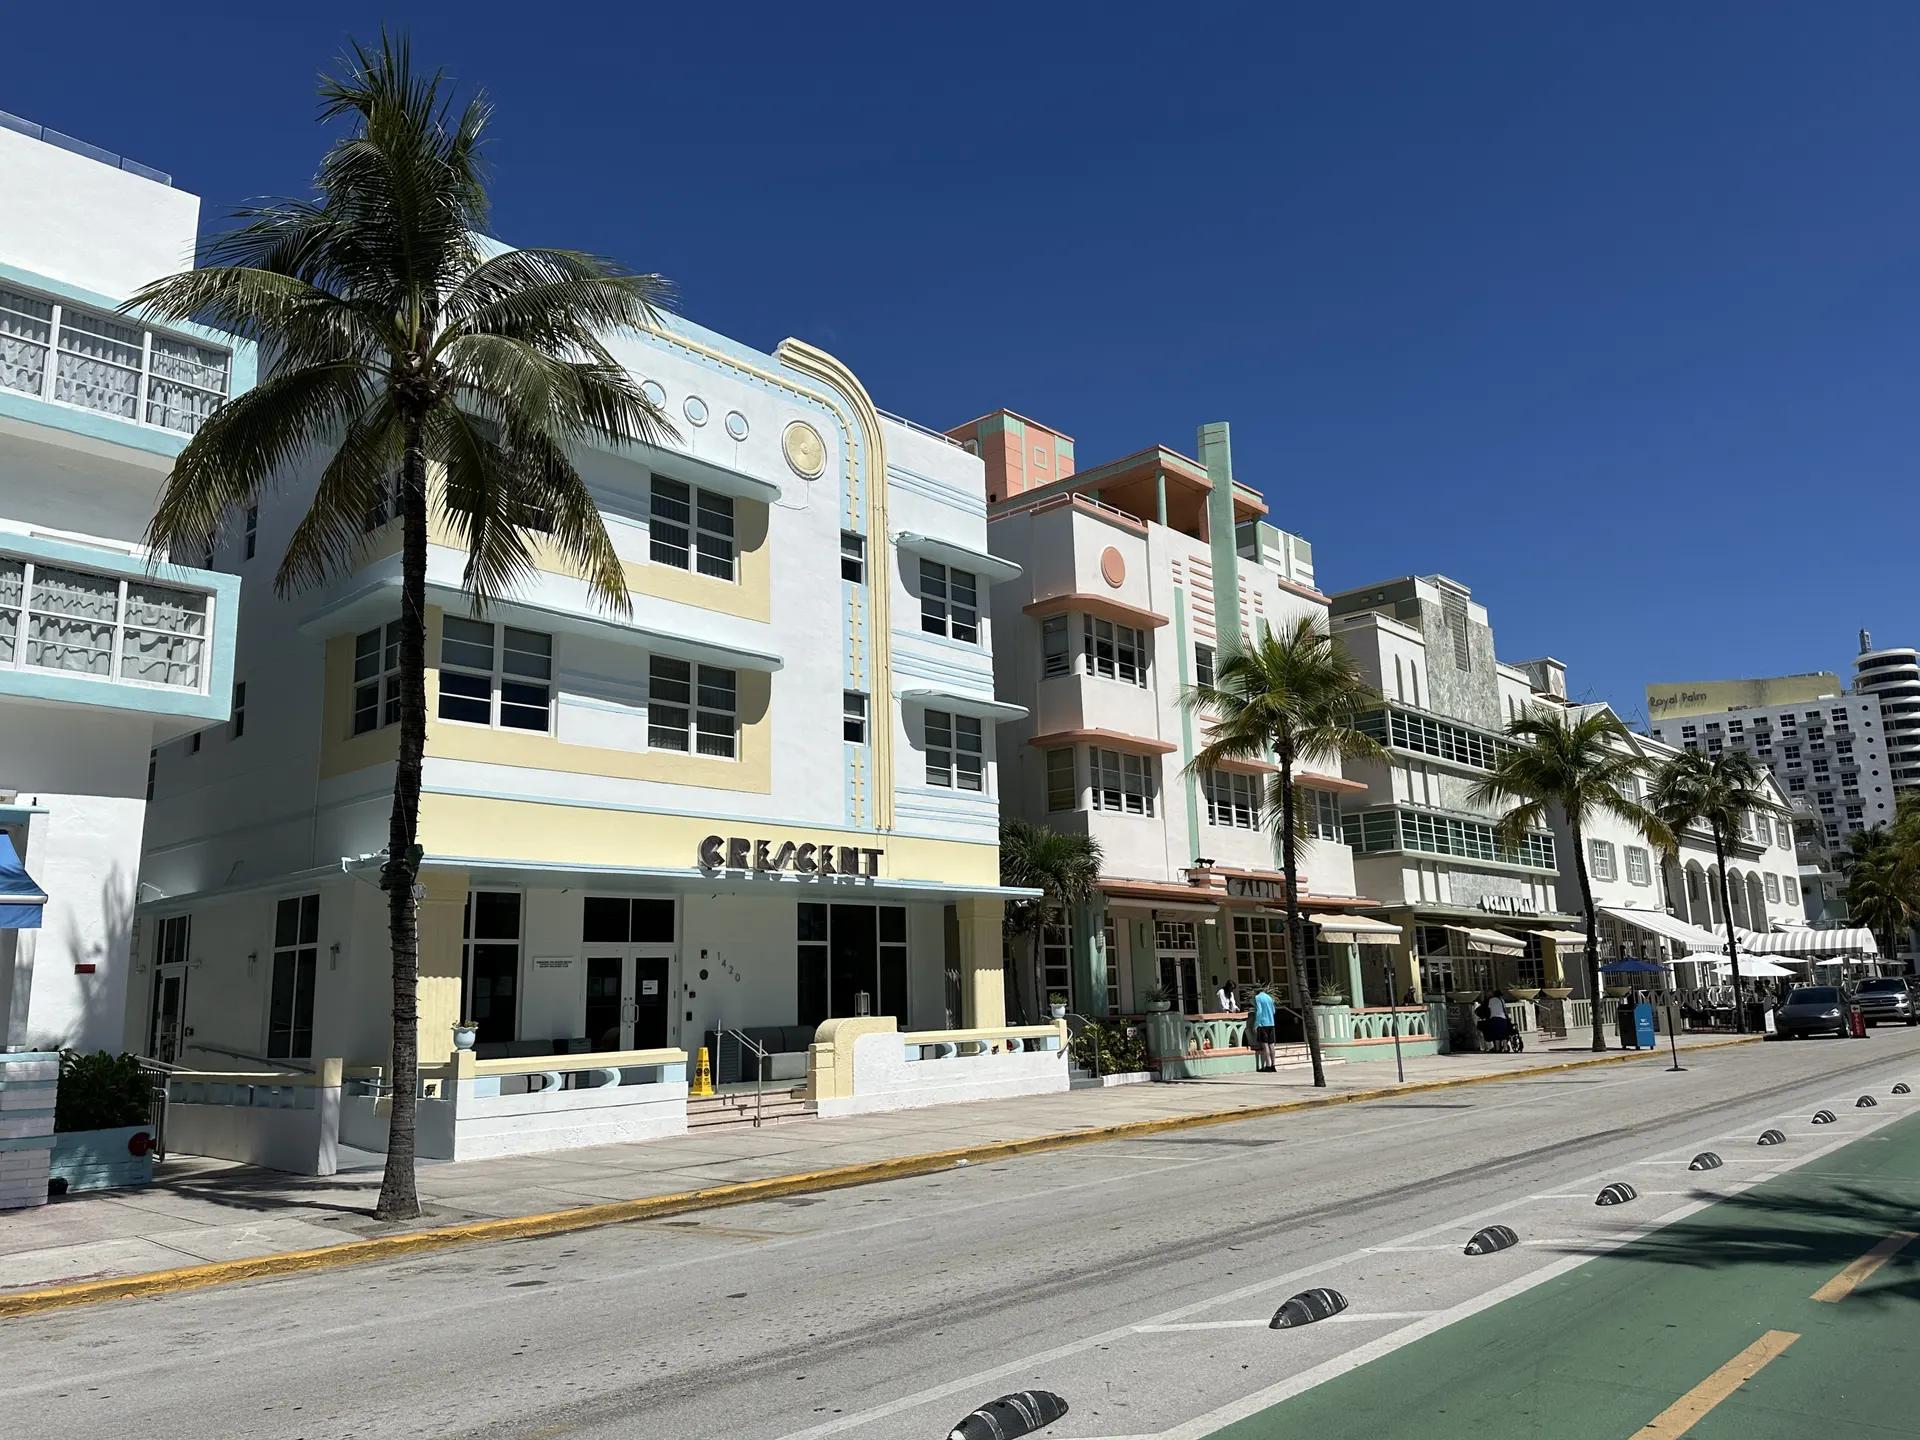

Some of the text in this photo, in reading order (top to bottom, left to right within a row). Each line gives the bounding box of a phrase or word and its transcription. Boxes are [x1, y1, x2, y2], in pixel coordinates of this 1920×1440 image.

[1650, 691, 1707, 711] Royal Palm
[697, 835, 885, 877] CRESCENT
[1481, 895, 1512, 911] OCEAN
[717, 951, 741, 982] 1420
